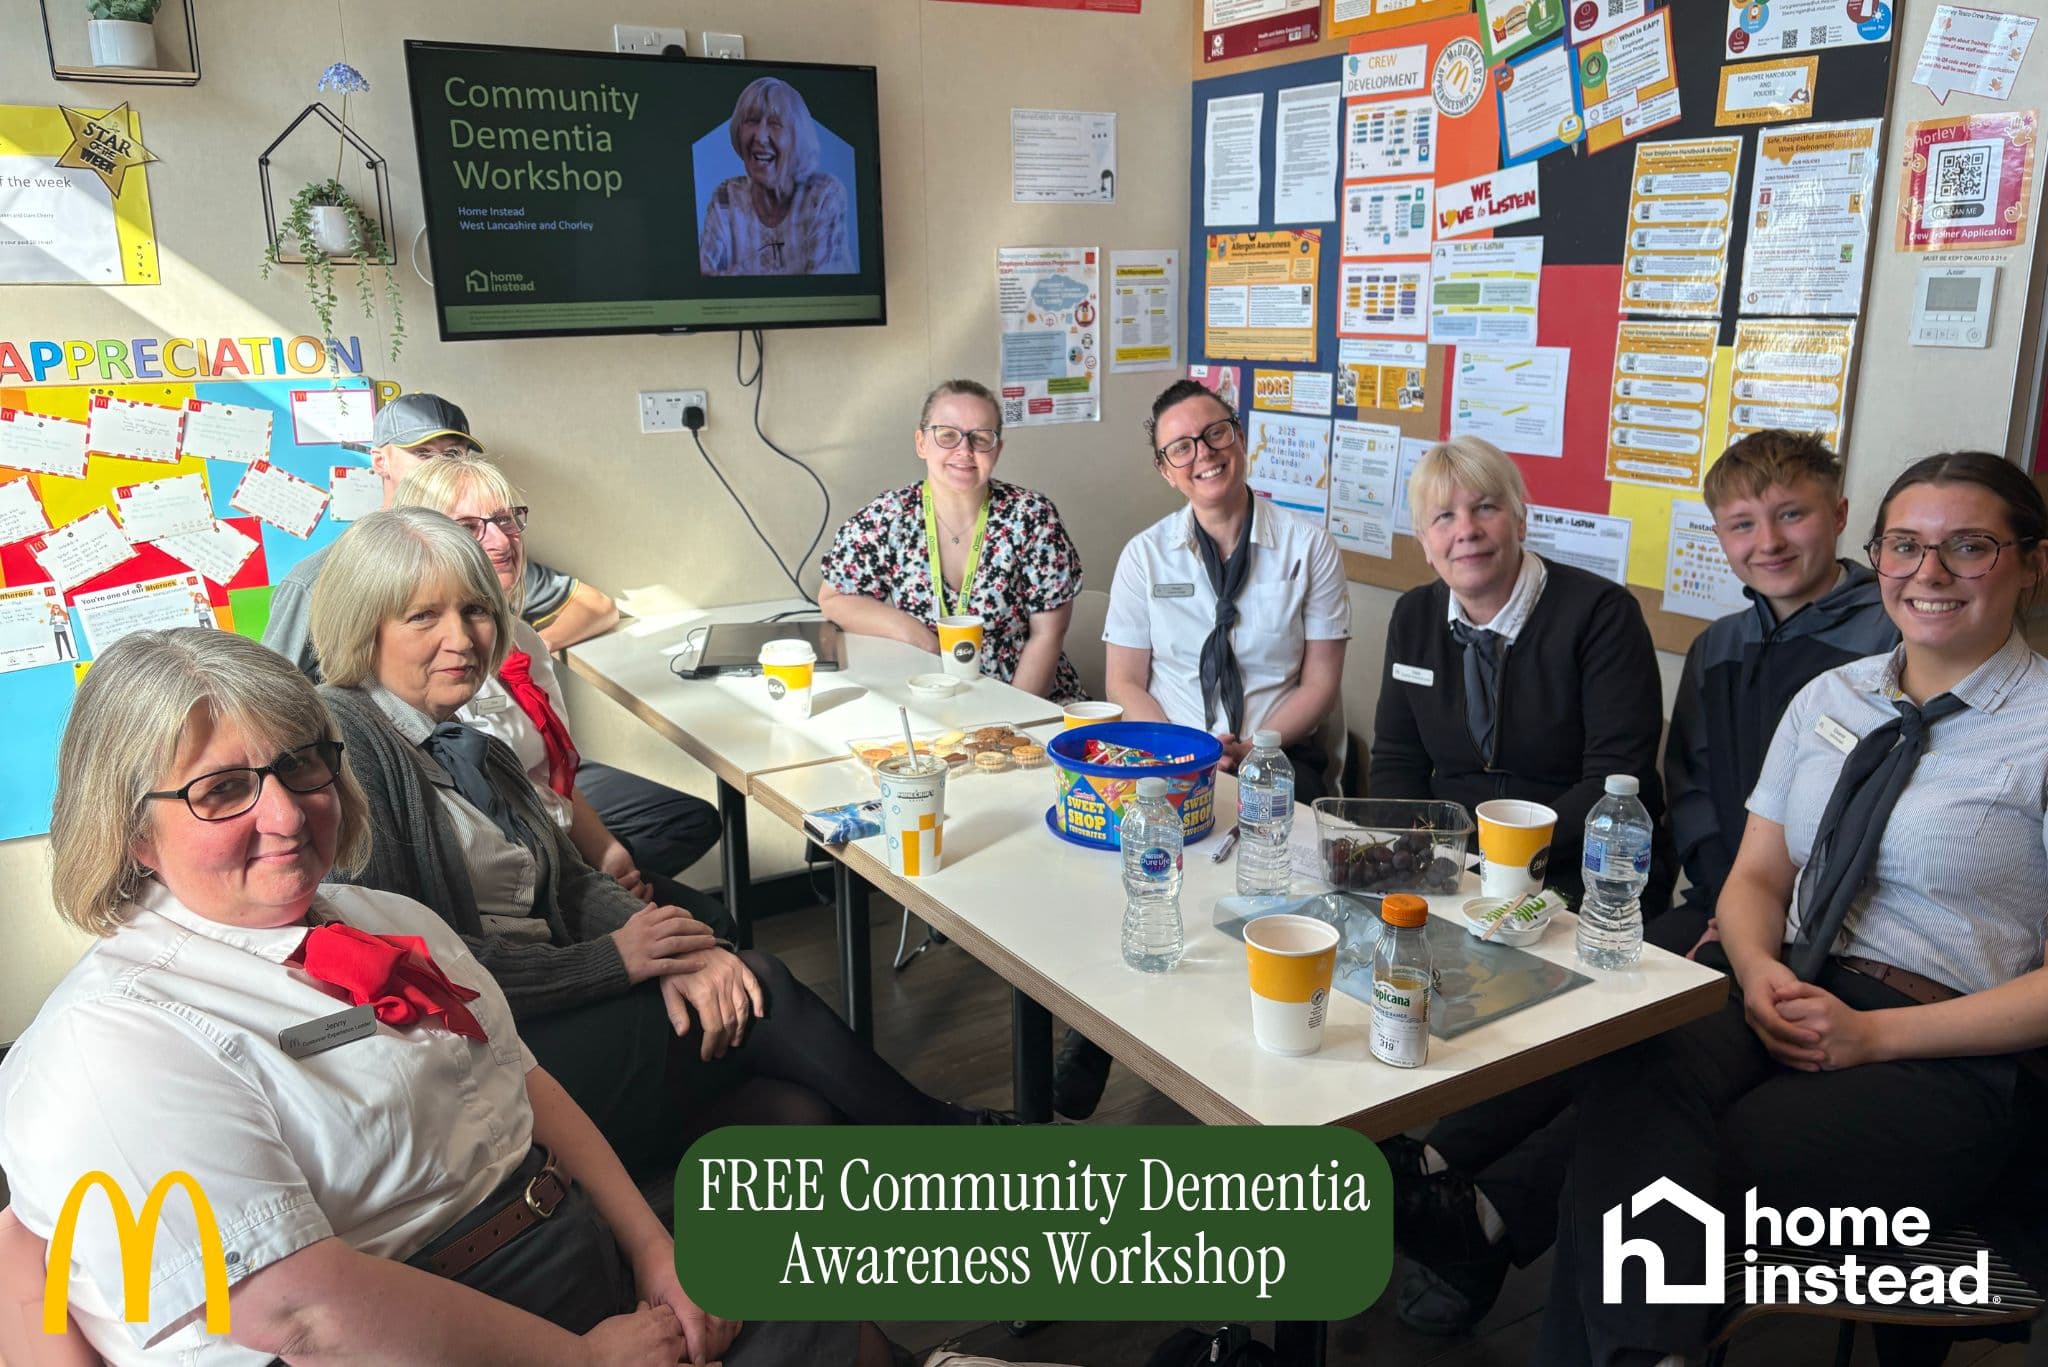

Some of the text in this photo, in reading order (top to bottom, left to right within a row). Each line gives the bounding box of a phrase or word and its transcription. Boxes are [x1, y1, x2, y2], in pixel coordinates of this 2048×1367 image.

[1619, 30, 1636, 42] What
[1642, 19, 1660, 32] EAP?
[1211, 47, 1225, 57] HSE
[1970, 39, 1988, 48] Training
[1368, 53, 1397, 70] CREW
[1347, 72, 1418, 91] DEVELOPMENT
[1737, 70, 1797, 82] EMPLOYEE HANDBOOK
[444, 76, 639, 120] Community
[1753, 89, 1776, 97] POLICIES
[82, 121, 132, 159] STAR
[450, 119, 613, 153] Dementia
[80, 148, 117, 175] WEEK
[8, 176, 72, 188] the week
[453, 159, 623, 197] Workshop
[1470, 180, 1493, 202] WE
[458, 207, 525, 216] Home Instead
[1477, 205, 1486, 217] to
[1488, 190, 1536, 216] LISTEN
[1944, 207, 1977, 217] SCAN ME
[459, 220, 594, 232] West Lancashire and Chorley
[1909, 232, 1929, 241] Crew
[1961, 227, 2013, 239] Application
[1231, 240, 1291, 252] Allergen Awareness
[490, 271, 523, 282] home
[491, 281, 535, 292] instead
[0, 336, 363, 382] APPRECIATION
[1257, 379, 1290, 396] MORE
[80, 594, 106, 606] You're
[105, 592, 122, 601] one
[122, 589, 131, 597] of
[130, 586, 145, 596] our
[1067, 795, 1105, 815] SWEET
[1068, 808, 1107, 831] SHOP
[1069, 825, 1107, 840] FAVOURITES
[1141, 857, 1170, 867] Pure Life
[1510, 897, 1547, 922] milk
[327, 1027, 355, 1038] Experience
